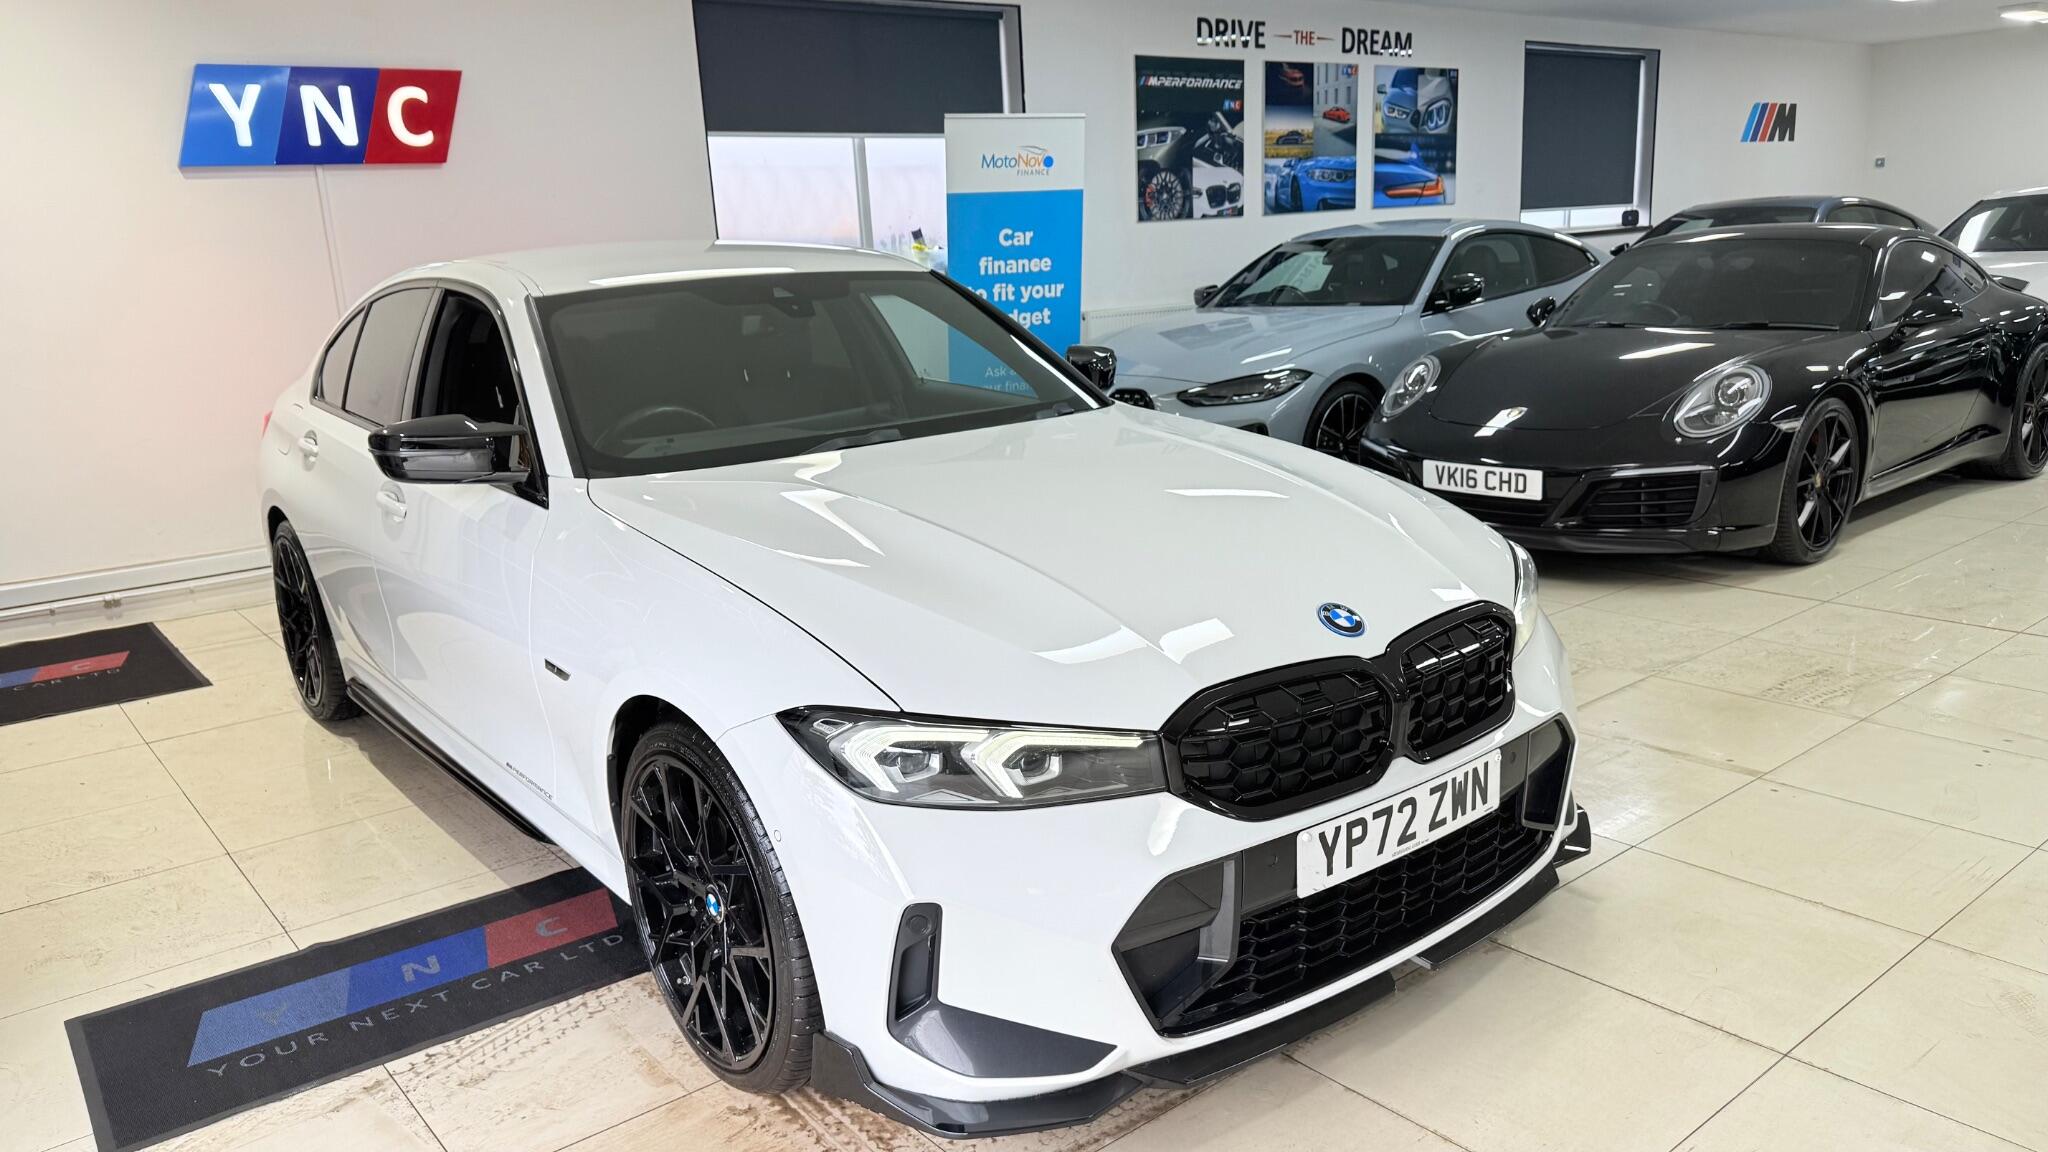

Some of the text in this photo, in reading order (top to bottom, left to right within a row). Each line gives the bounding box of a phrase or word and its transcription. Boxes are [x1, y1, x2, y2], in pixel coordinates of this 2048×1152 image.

[1196, 17, 1413, 57] DRIVE THE DREAM
[208, 83, 434, 147] YNC
[1016, 168, 1050, 177] FINANCE
[998, 227, 1034, 247] Car
[978, 256, 1052, 276] finance
[968, 282, 1065, 303] o fit your
[1008, 307, 1052, 329] dget
[984, 367, 1007, 378] Ask
[1435, 464, 1527, 494] VK16 CHD
[1318, 760, 1489, 877] YP72 ZWN
[207, 934, 624, 1077] YOUR NEXT CAR LTD
